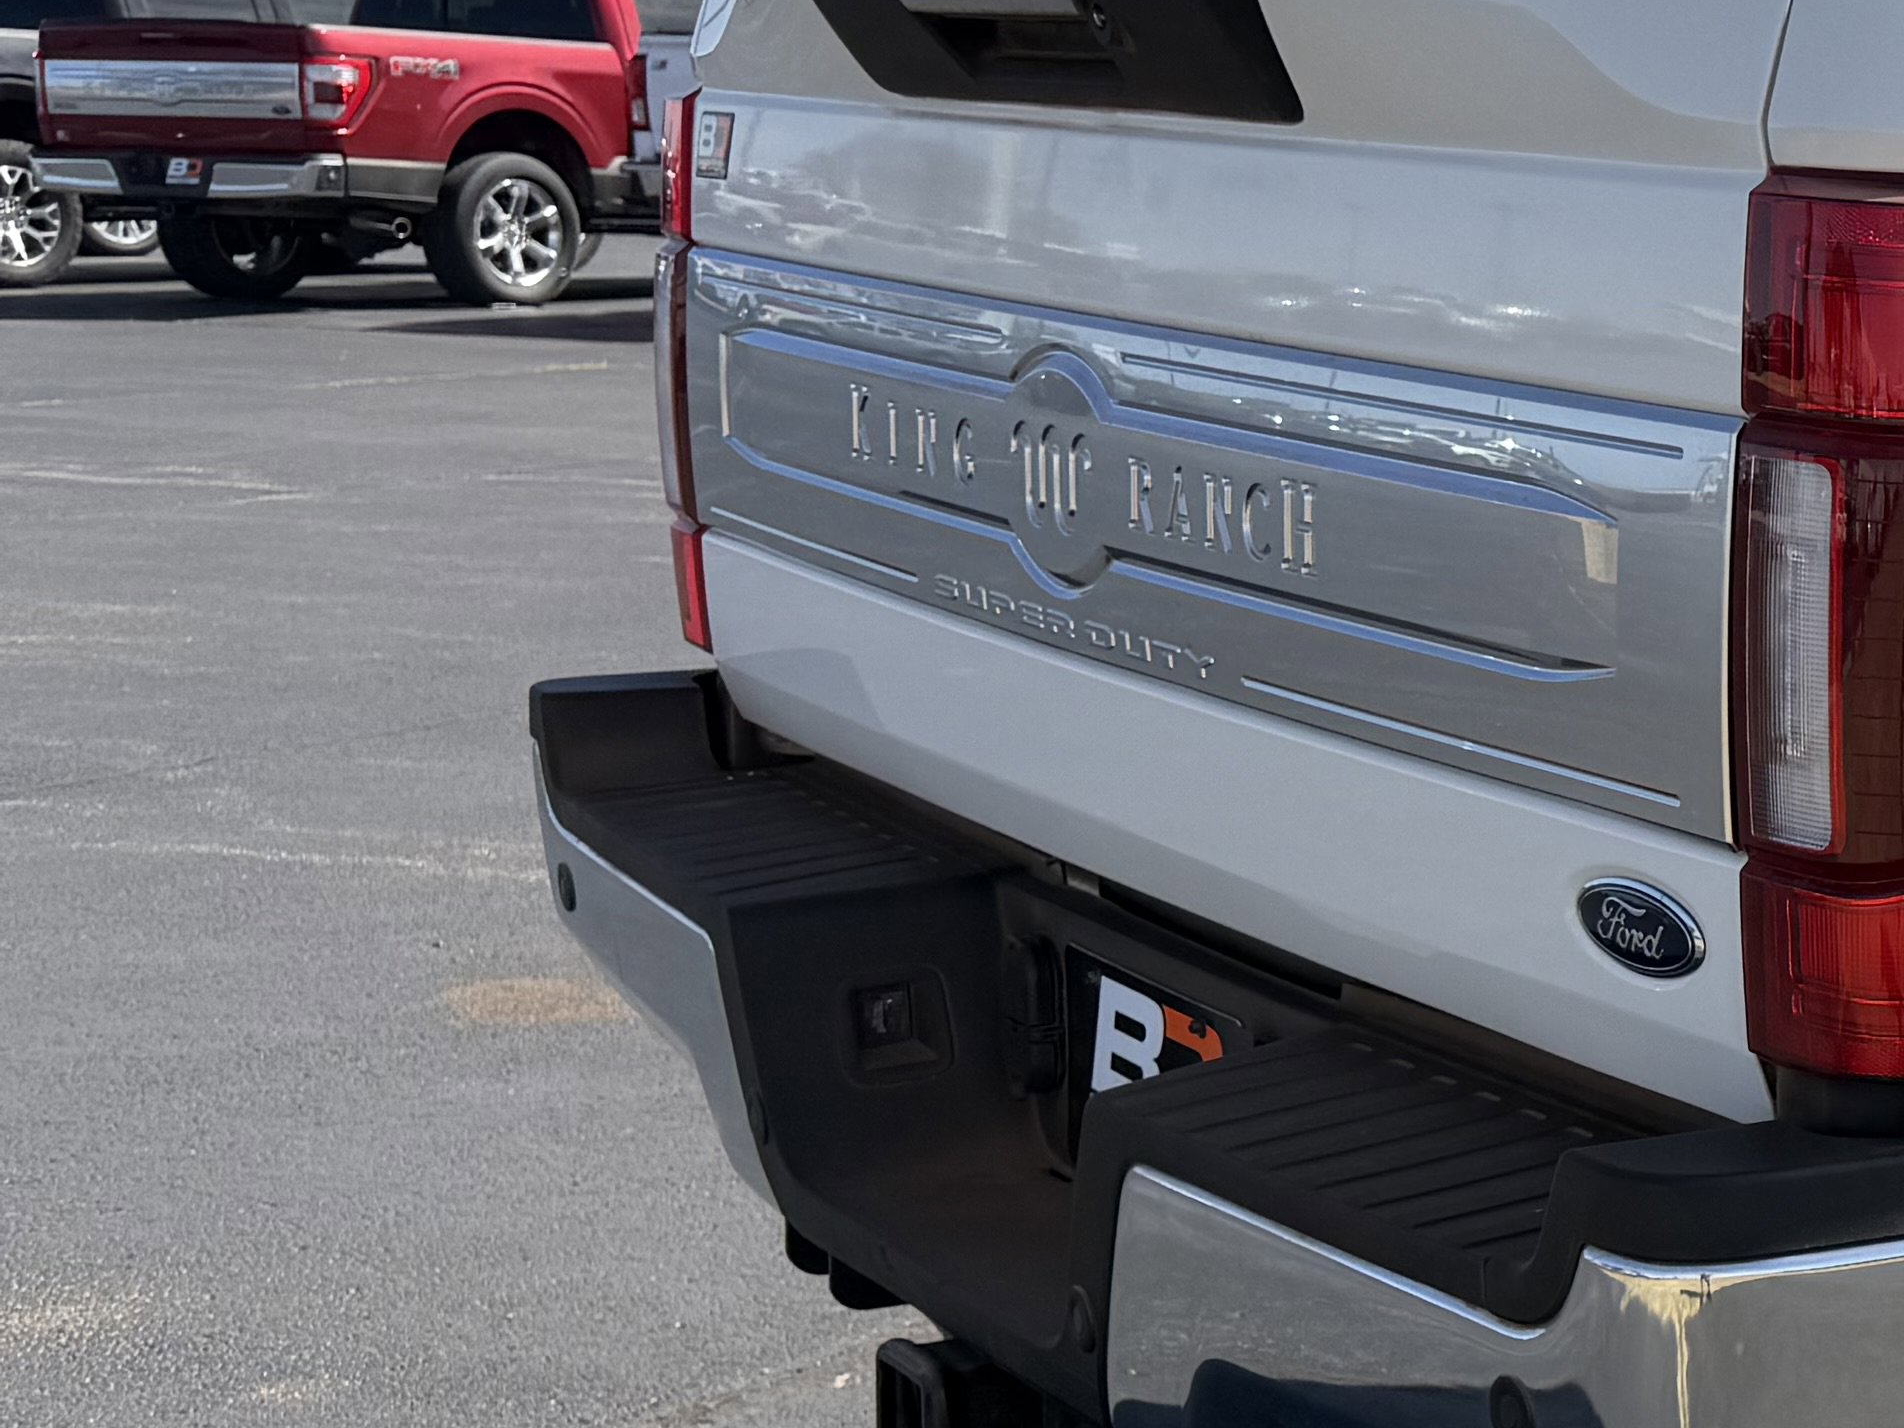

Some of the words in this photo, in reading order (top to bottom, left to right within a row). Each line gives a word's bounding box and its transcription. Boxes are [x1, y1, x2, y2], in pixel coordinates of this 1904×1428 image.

[849, 383, 976, 487] KING
[1127, 455, 1319, 575] RANCH
[934, 573, 1076, 639] SUPER
[1084, 619, 1215, 679] DUTY
[1596, 896, 1665, 960] Ford
